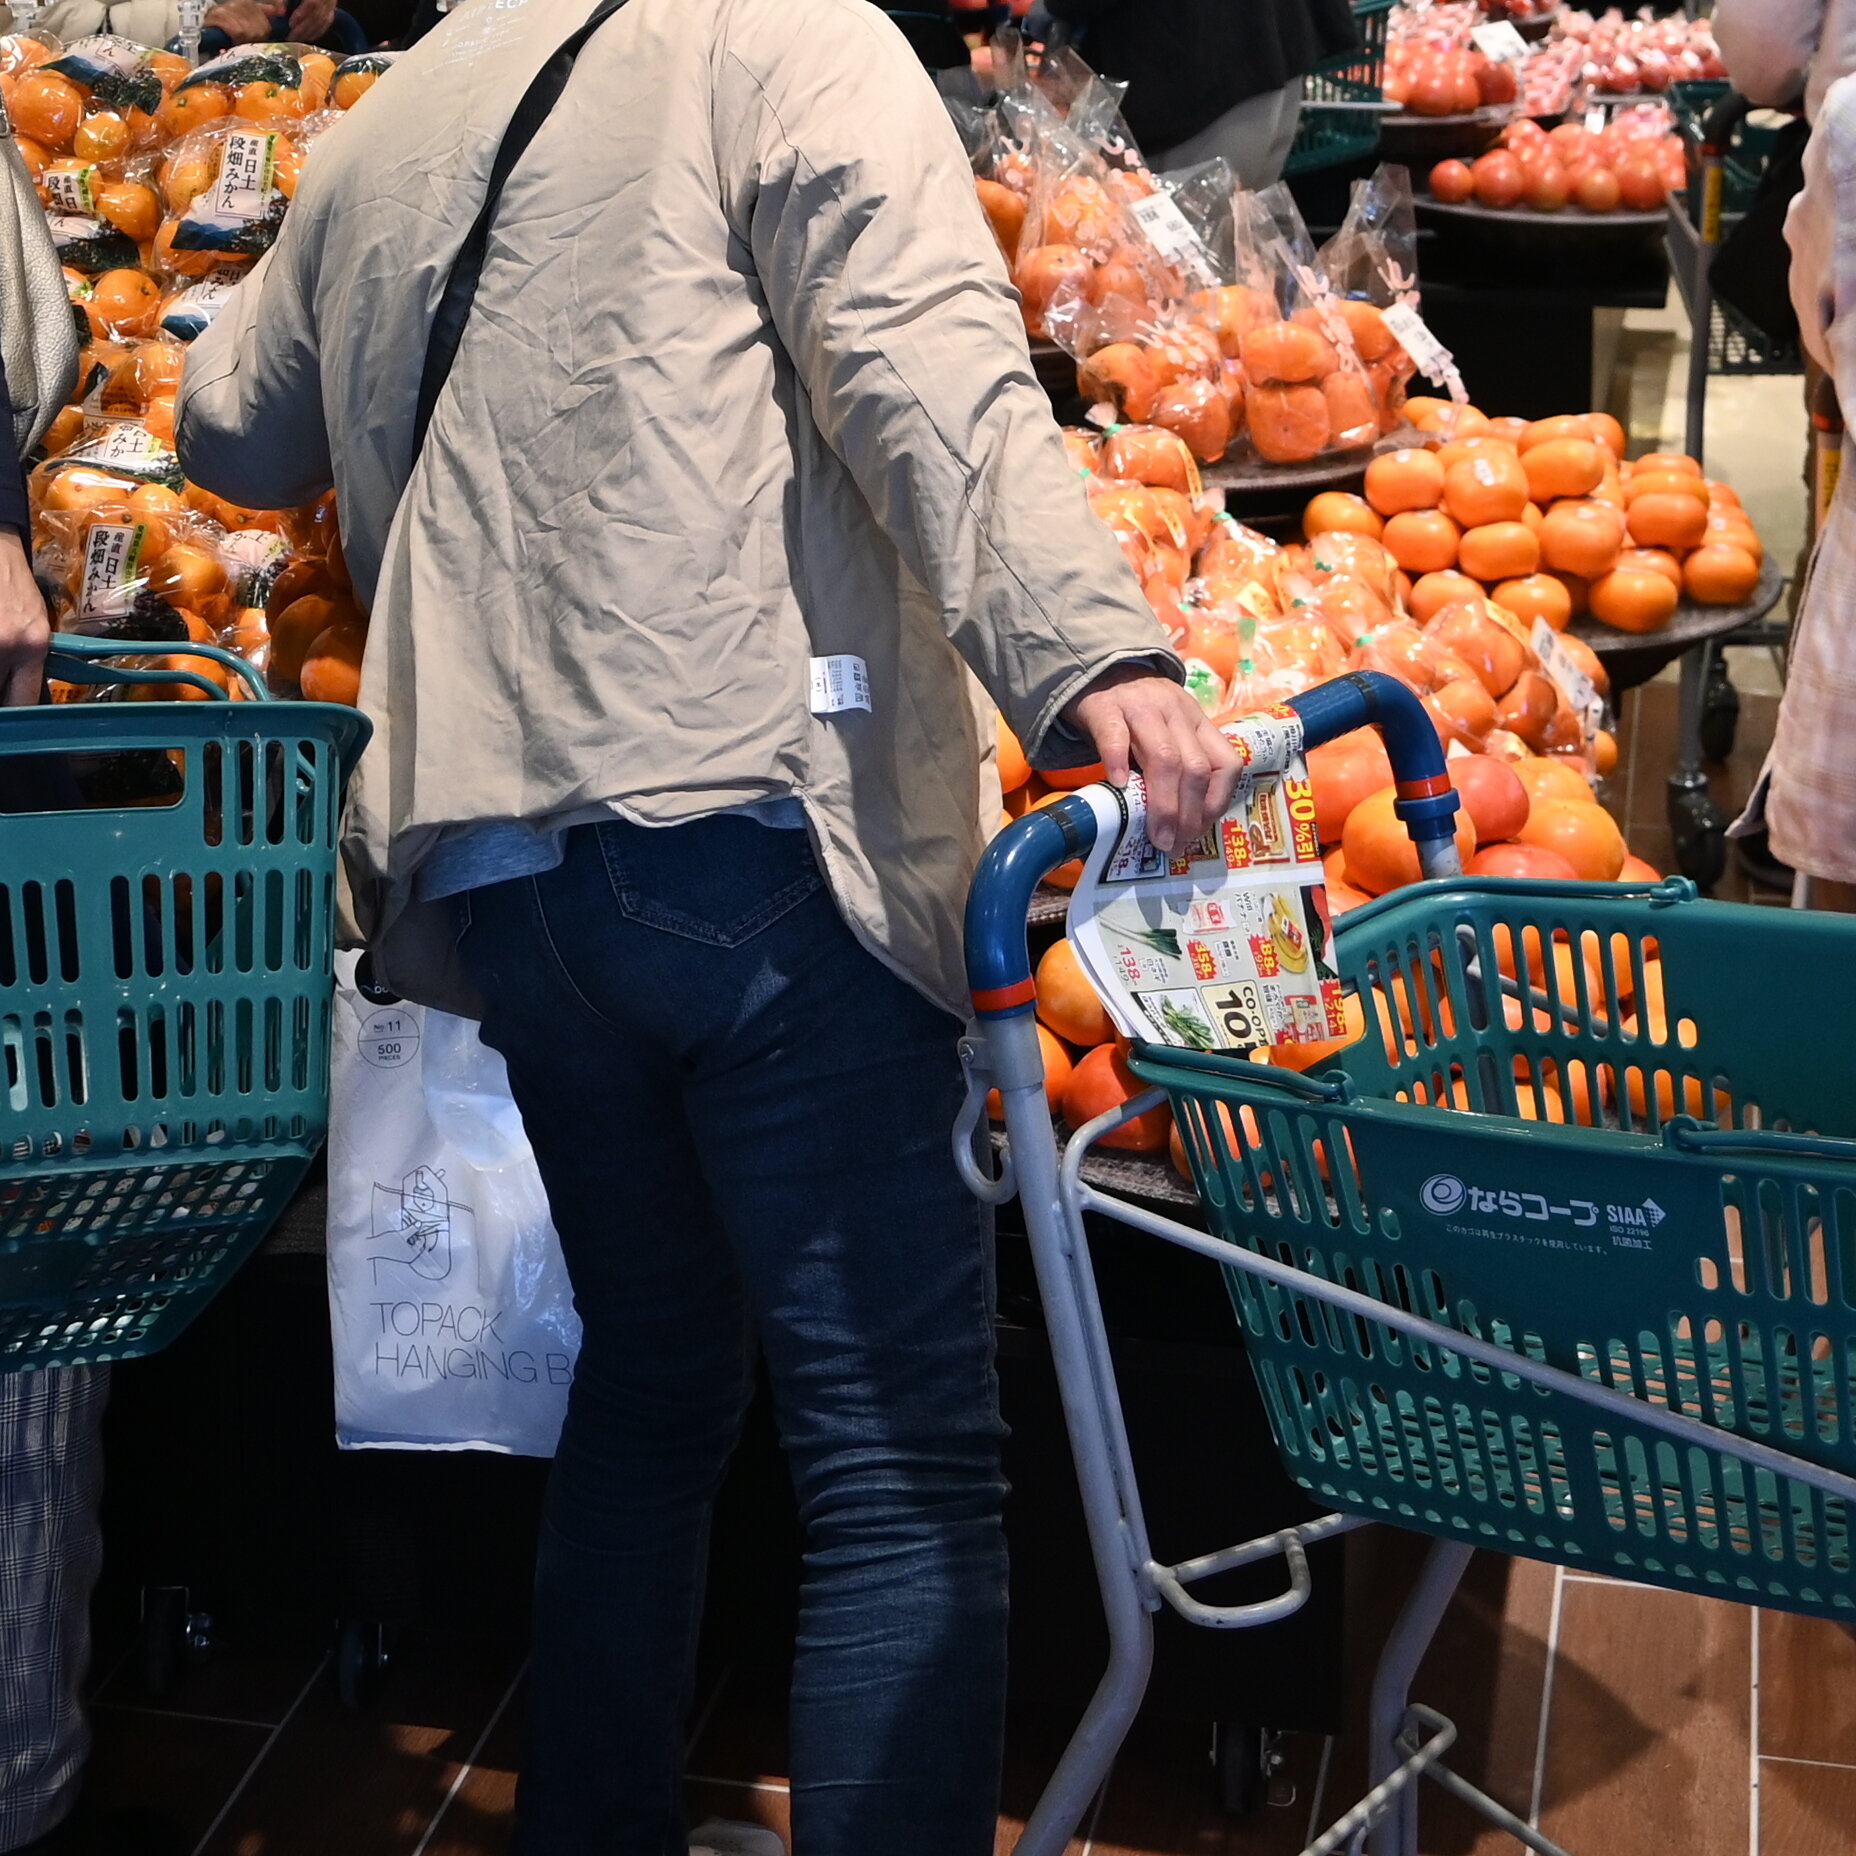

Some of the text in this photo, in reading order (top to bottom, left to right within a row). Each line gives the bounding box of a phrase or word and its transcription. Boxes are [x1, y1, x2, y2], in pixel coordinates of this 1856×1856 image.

[221, 136, 246, 209] 段畑みかん
[239, 159, 257, 191] 日土
[1213, 988, 1254, 1051] 10
[378, 1043, 402, 1055] 500
[1468, 1185, 1599, 1227] ならコープ
[1606, 1204, 1648, 1227] SIAA
[369, 1301, 506, 1346] TOPACK
[375, 1341, 539, 1384] HANGING
